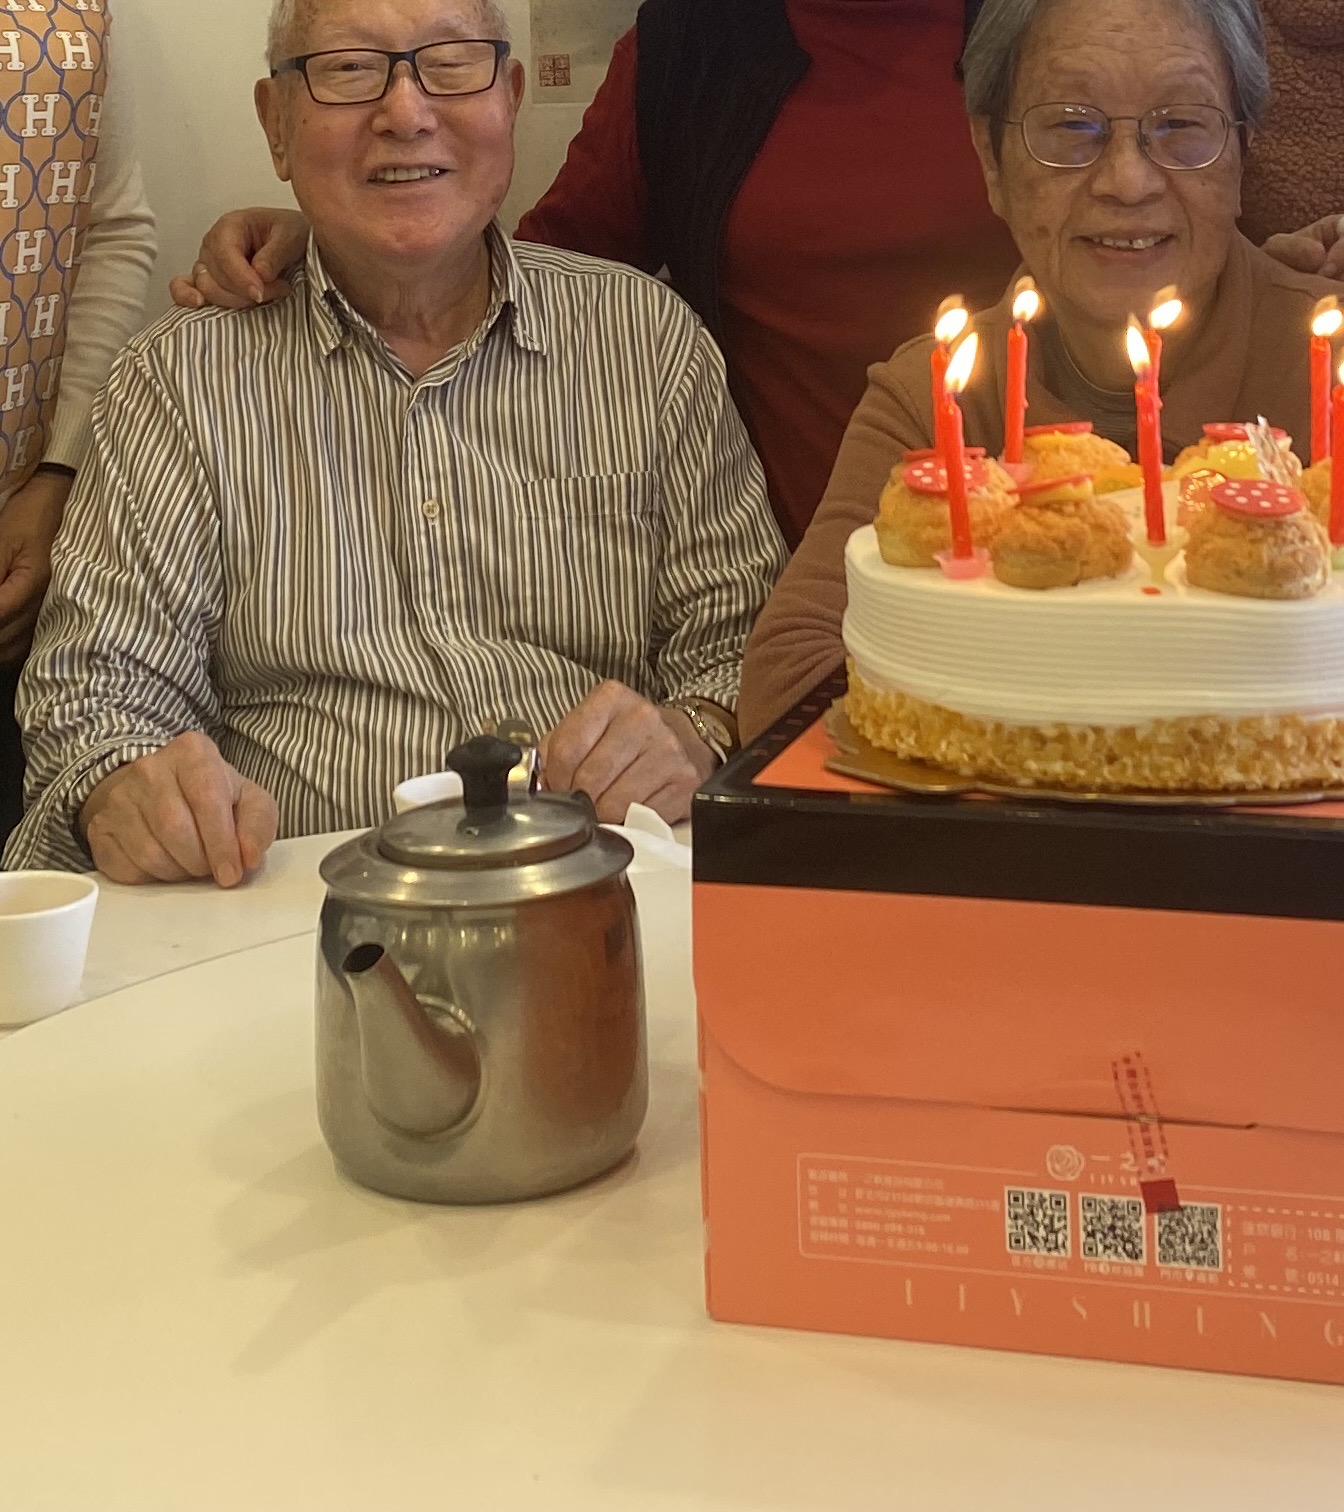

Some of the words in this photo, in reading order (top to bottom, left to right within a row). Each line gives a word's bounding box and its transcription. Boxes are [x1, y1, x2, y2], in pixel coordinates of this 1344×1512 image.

[54, 28, 95, 70] H
[21, 94, 61, 139] H
[47, 162, 84, 205] H
[14, 229, 47, 275] H
[33, 294, 60, 339] H
[3, 364, 29, 412] H
